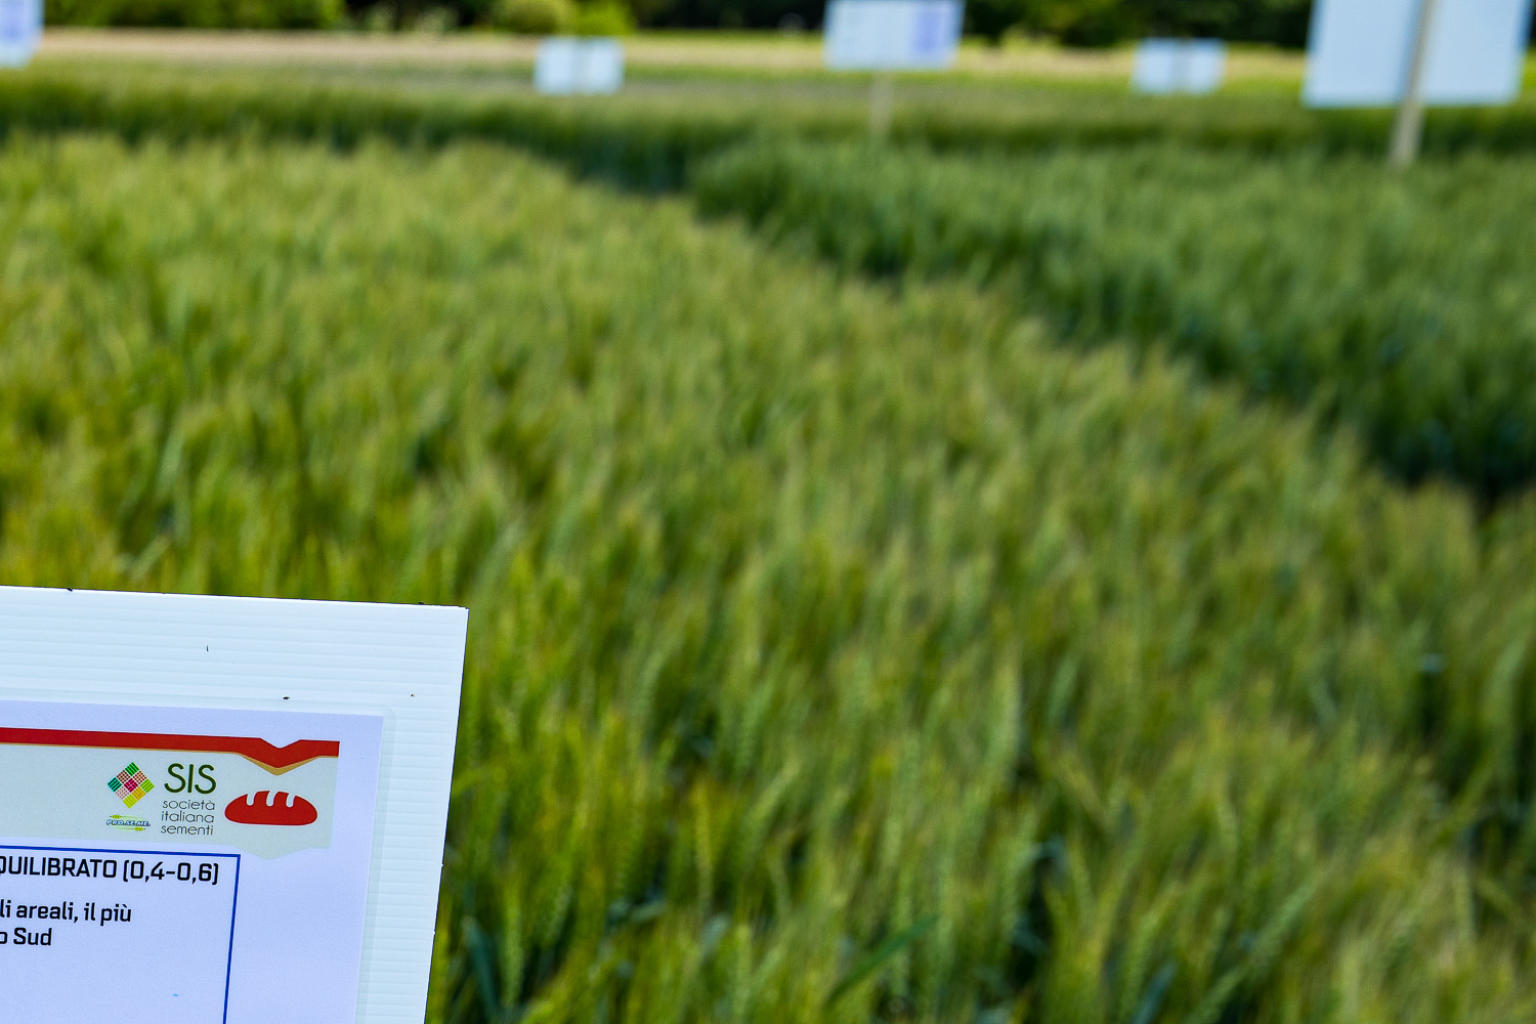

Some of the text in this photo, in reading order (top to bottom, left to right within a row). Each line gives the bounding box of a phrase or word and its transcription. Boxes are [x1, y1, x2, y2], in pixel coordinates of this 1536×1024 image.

[164, 762, 217, 795] SIS
[162, 799, 215, 811] società
[160, 811, 215, 823] italiana
[160, 824, 214, 836] sementi
[15, 899, 78, 922] areali,
[82, 901, 96, 922] il
[99, 902, 132, 927] più
[13, 926, 52, 947] Sud
